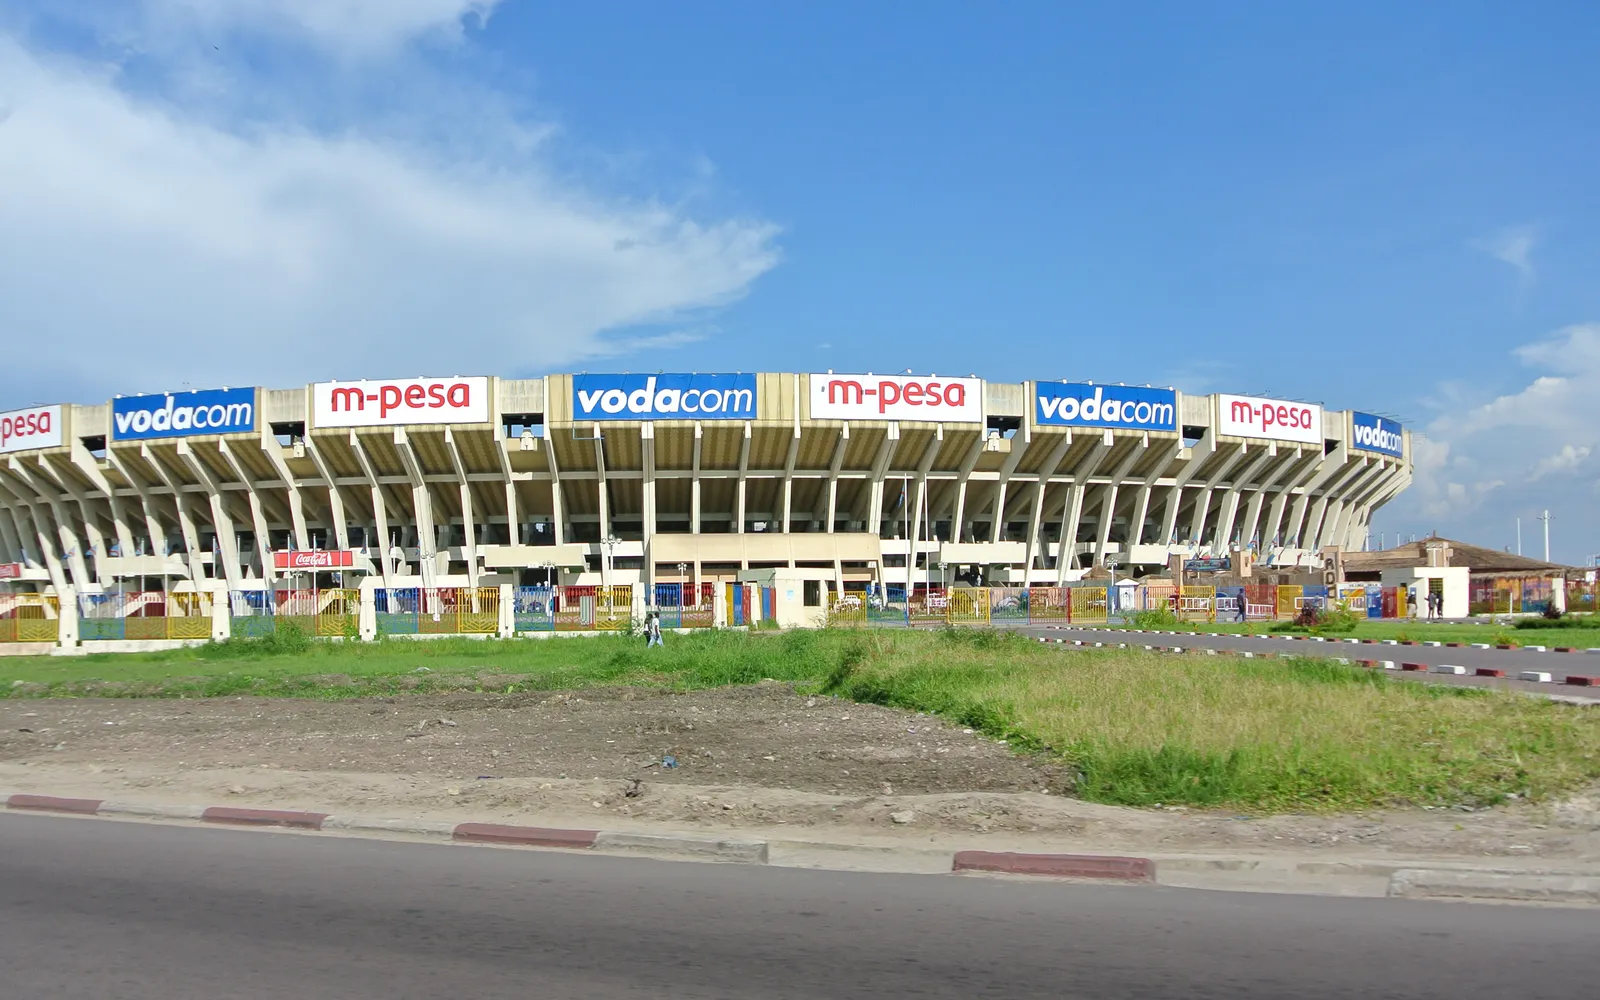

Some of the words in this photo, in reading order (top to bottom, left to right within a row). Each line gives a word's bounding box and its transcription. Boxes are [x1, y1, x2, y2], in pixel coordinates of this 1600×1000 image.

[331, 383, 470, 419] m-pesa
[577, 377, 753, 413] vodacom
[828, 380, 965, 414] m-pesa
[1038, 387, 1174, 425] vodacom
[115, 396, 252, 433] vodacom
[1231, 400, 1312, 433] m-pesa
[1354, 418, 1402, 454] vodacom
[295, 553, 327, 566] Coca-Cola
